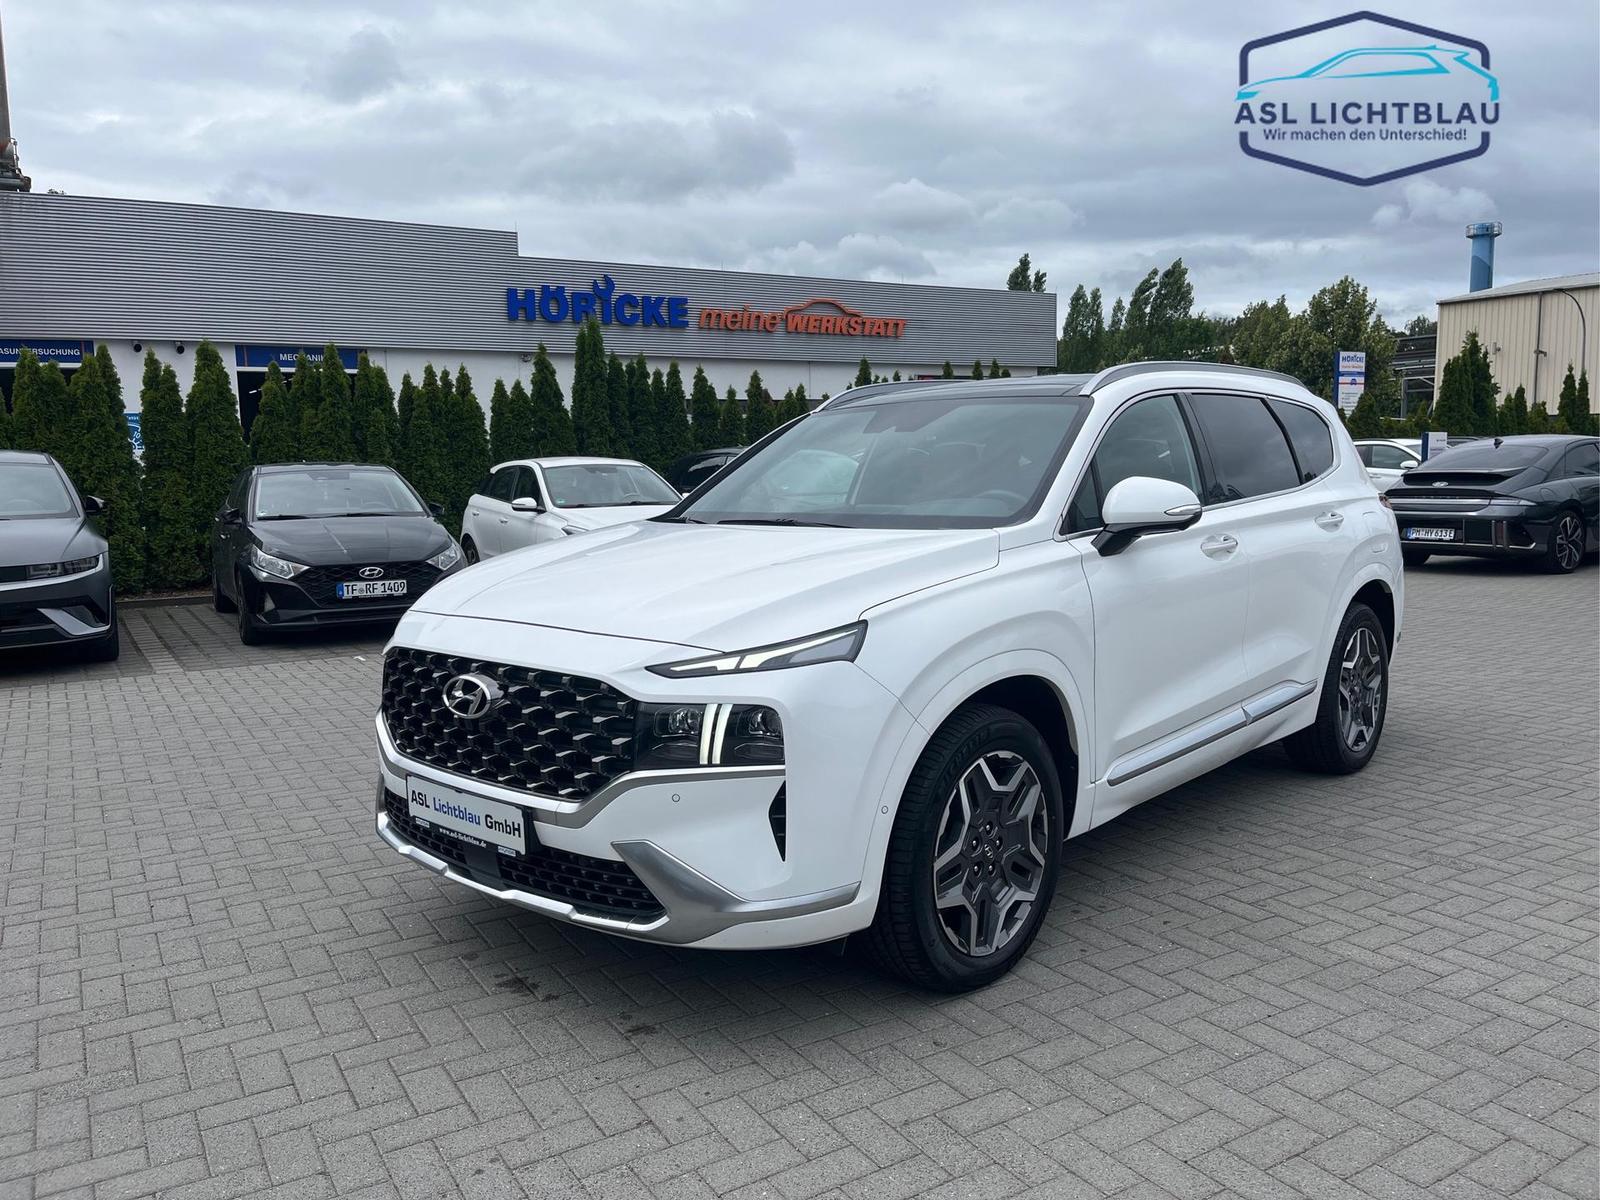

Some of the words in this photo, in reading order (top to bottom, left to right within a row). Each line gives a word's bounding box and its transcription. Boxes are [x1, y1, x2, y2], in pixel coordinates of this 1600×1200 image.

[507, 274, 689, 328] HÖRICKE
[699, 304, 780, 333] meine
[787, 313, 906, 338] WERKSTATT
[344, 584, 357, 595] TF
[365, 582, 378, 594] RF
[380, 581, 406, 593] 1409
[411, 789, 430, 809] ASL
[433, 797, 481, 826] Lichtblau
[484, 814, 521, 838] GmbH
